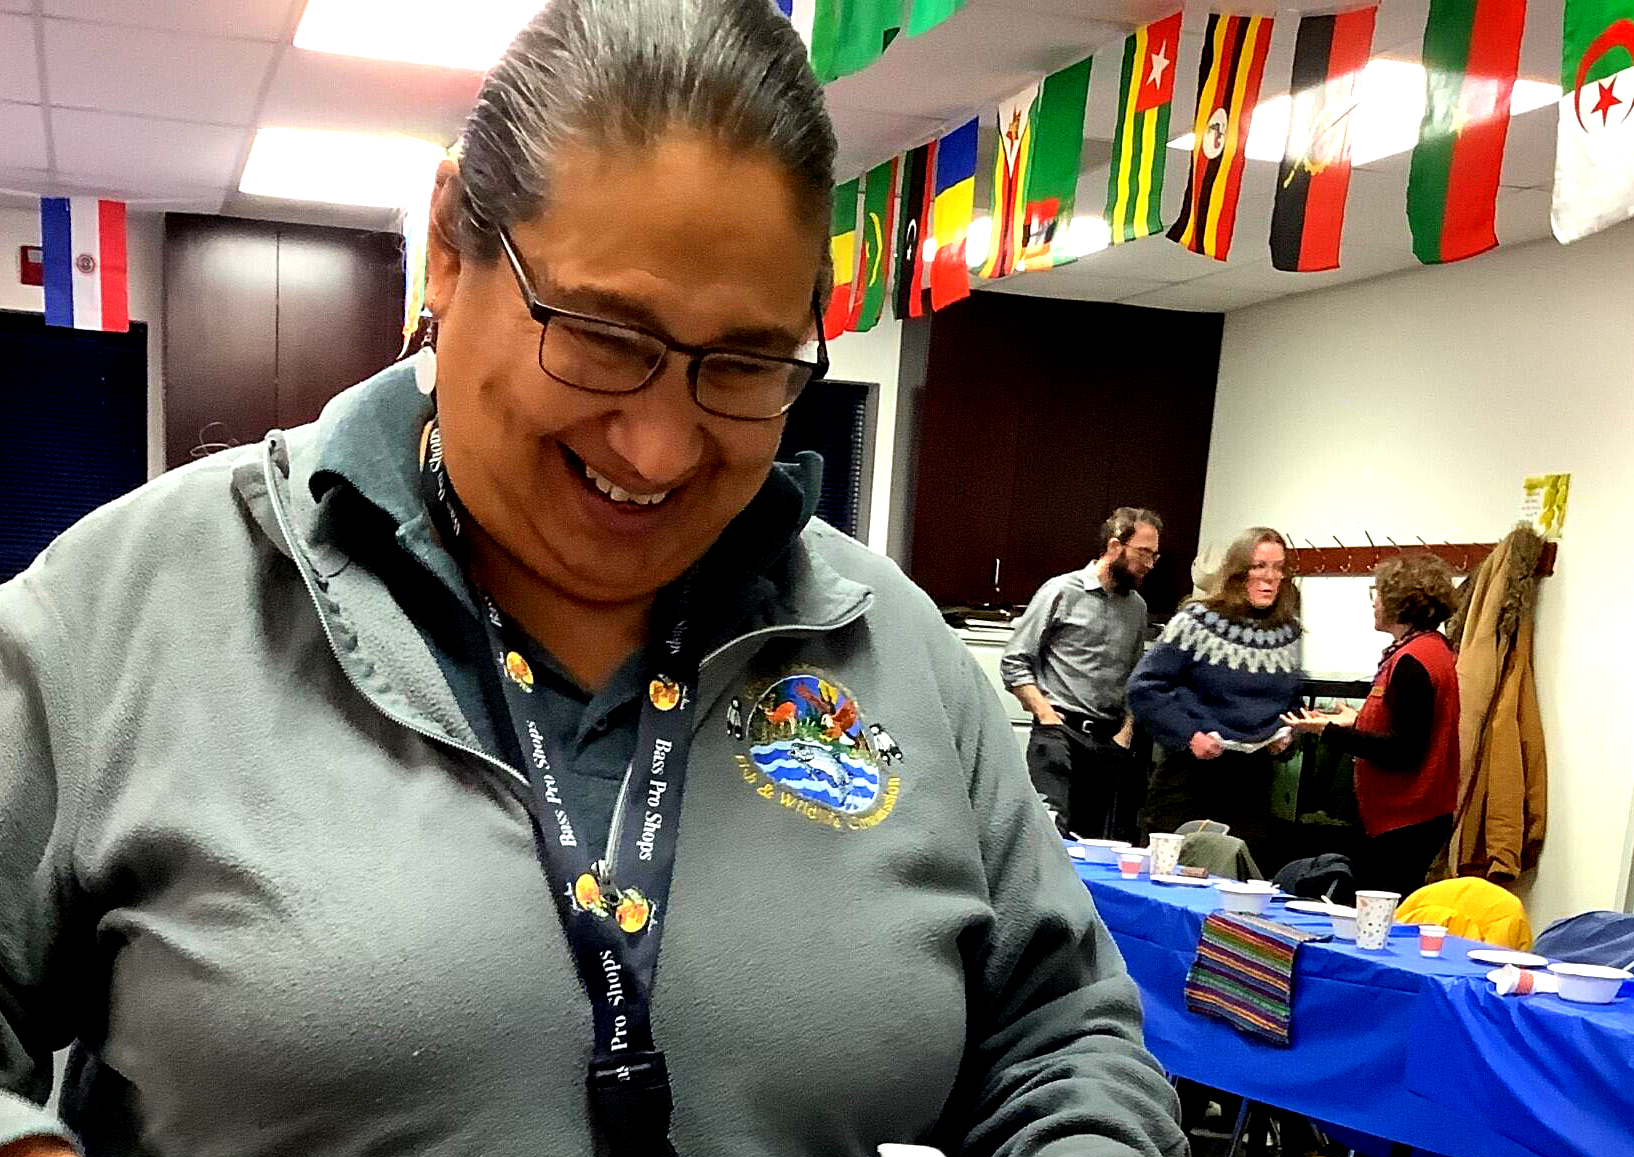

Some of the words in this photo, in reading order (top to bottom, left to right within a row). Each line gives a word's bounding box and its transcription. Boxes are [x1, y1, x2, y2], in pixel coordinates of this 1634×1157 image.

[526, 720, 550, 770] Shops
[651, 738, 673, 775] Bass
[544, 774, 562, 804] Pro
[646, 779, 668, 807] Pro
[757, 783, 774, 799] &
[555, 810, 578, 847] Bass
[636, 810, 663, 861] Shops
[599, 950, 625, 1007] Shops
[610, 1015, 628, 1051] Pro
